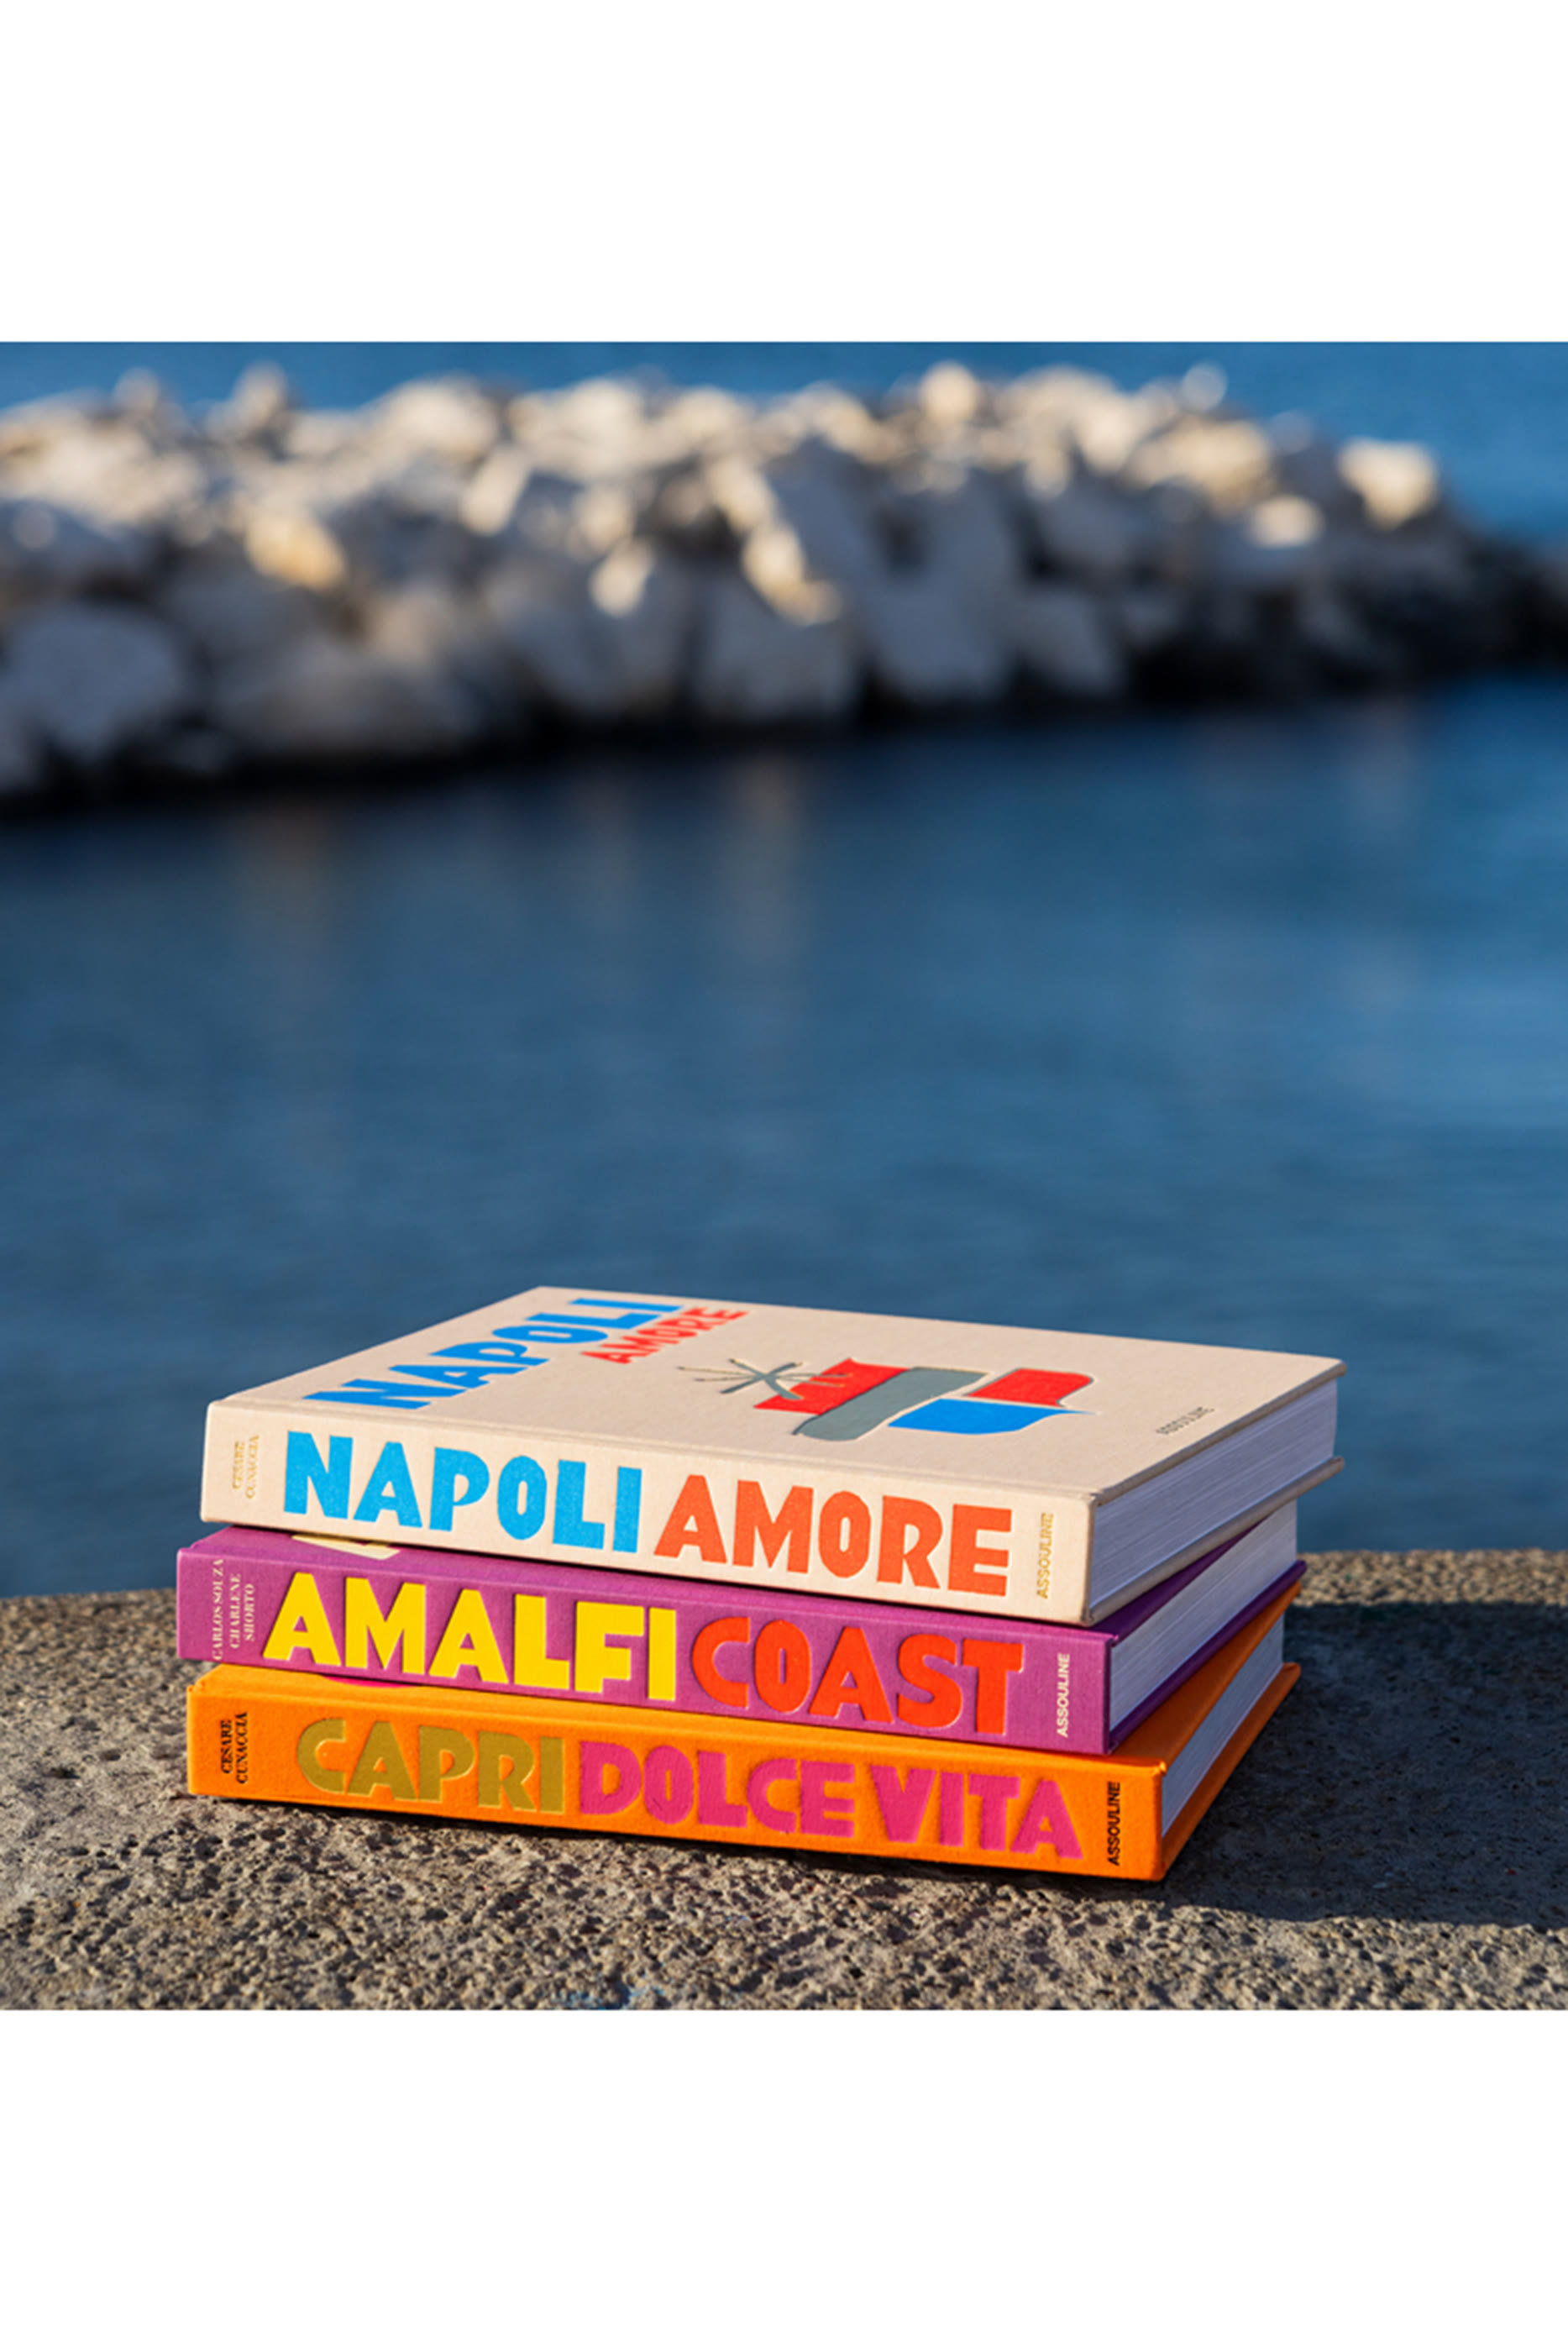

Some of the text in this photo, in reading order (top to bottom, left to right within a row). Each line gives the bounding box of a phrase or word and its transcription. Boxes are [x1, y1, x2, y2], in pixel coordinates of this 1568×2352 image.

[302, 1298, 683, 1410] NAPOLI
[580, 1307, 749, 1364] AMORE
[283, 1431, 1012, 1596] NAPOLI AMORE
[1036, 1513, 1054, 1599] ASSOULINE
[212, 1559, 223, 1661] CARLOS SOUZA
[229, 1573, 241, 1648] CHARLENE
[244, 1583, 255, 1641] SHORTO
[262, 1572, 1024, 1735] AMALFI COAST
[1056, 1653, 1071, 1738] ASSOULINE
[220, 1719, 233, 1774] CESARE
[235, 1712, 249, 1784] CUNACCIA
[296, 1718, 1083, 1860] CAPRI DOLCE VITA
[1107, 1781, 1122, 1866] ASSOULINE
